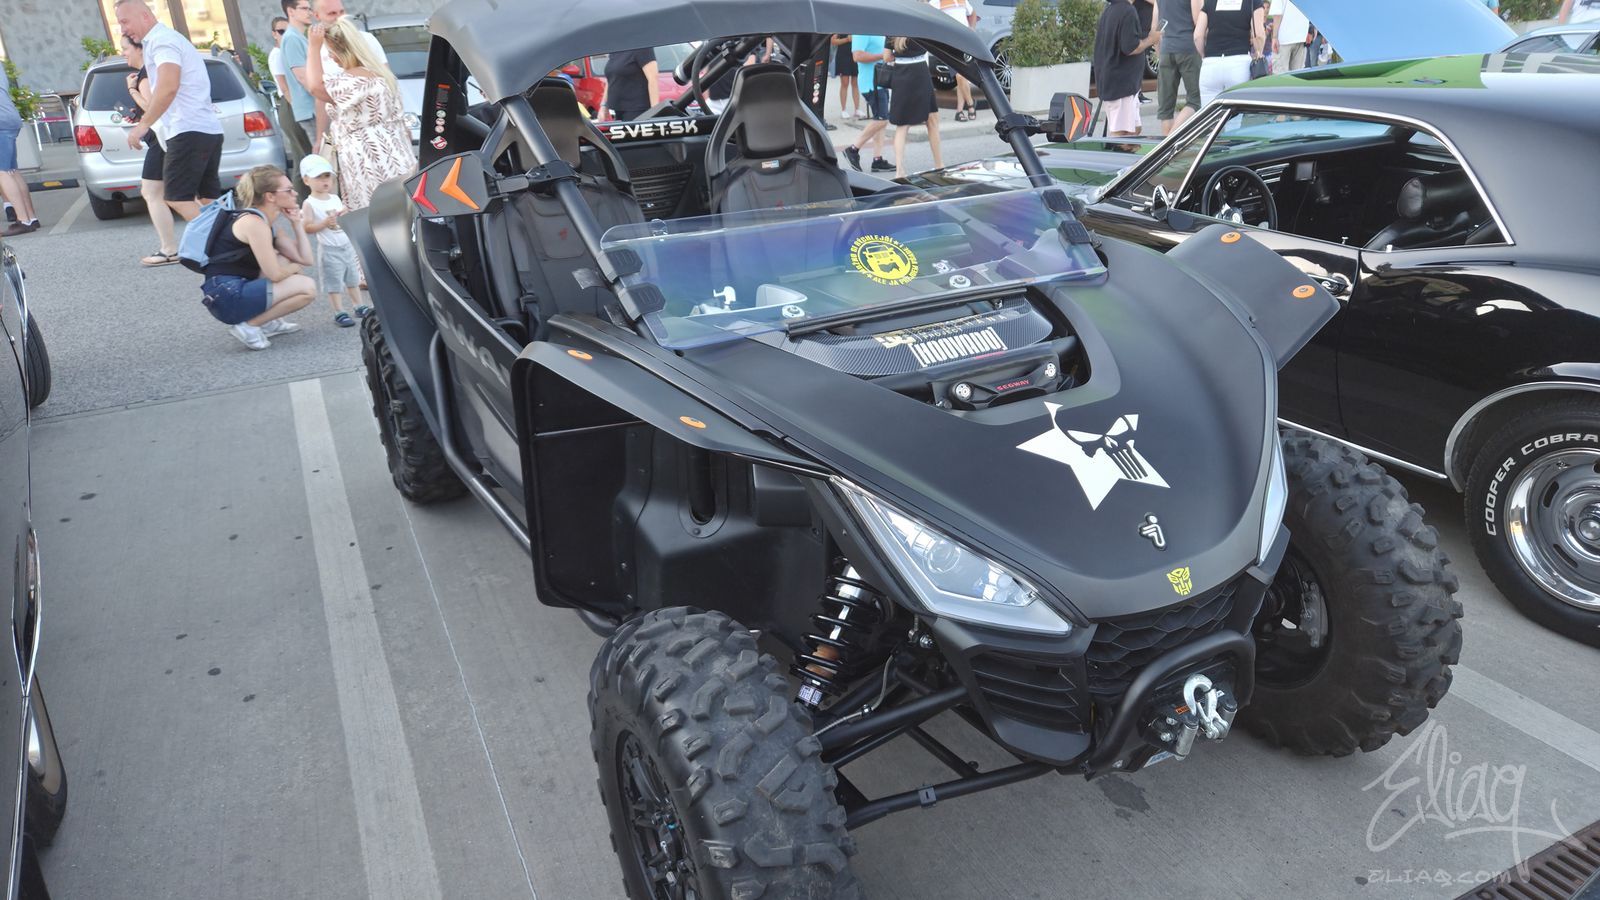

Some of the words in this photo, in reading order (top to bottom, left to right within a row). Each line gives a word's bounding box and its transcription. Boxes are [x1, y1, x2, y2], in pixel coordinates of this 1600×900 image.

[610, 120, 698, 139] SVET.SK
[996, 379, 1030, 391] SEGWAY
[1485, 457, 1516, 536] COOPER
[1521, 433, 1599, 455] COBRA
